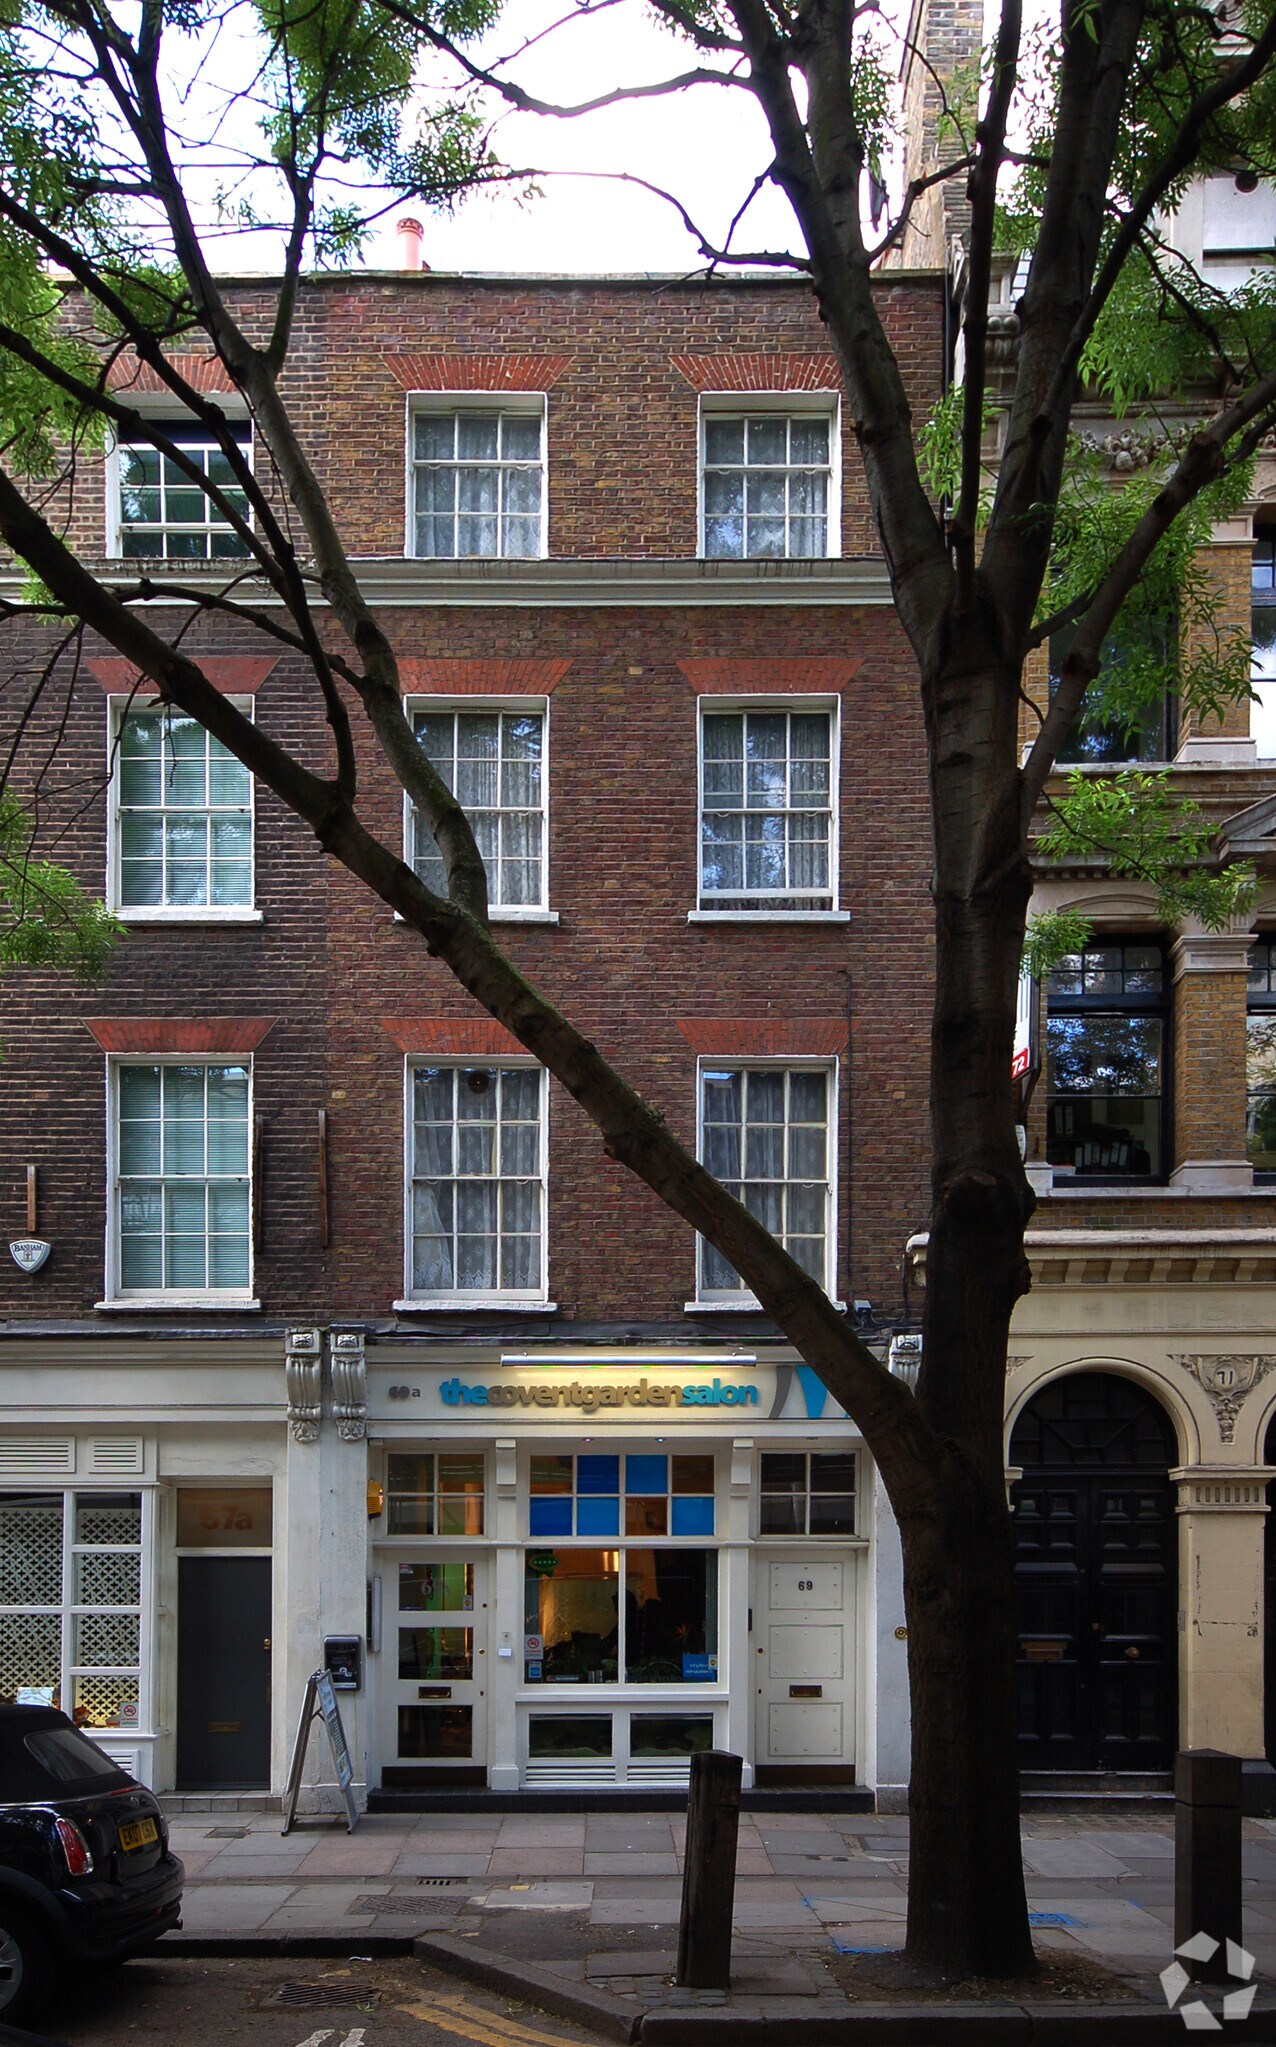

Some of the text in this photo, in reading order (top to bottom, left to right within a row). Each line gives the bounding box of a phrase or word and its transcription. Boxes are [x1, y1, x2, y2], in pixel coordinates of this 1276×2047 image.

[1217, 1371, 1233, 1385] 71
[201, 1506, 253, 1530] 67a
[798, 1580, 813, 1591] 69
